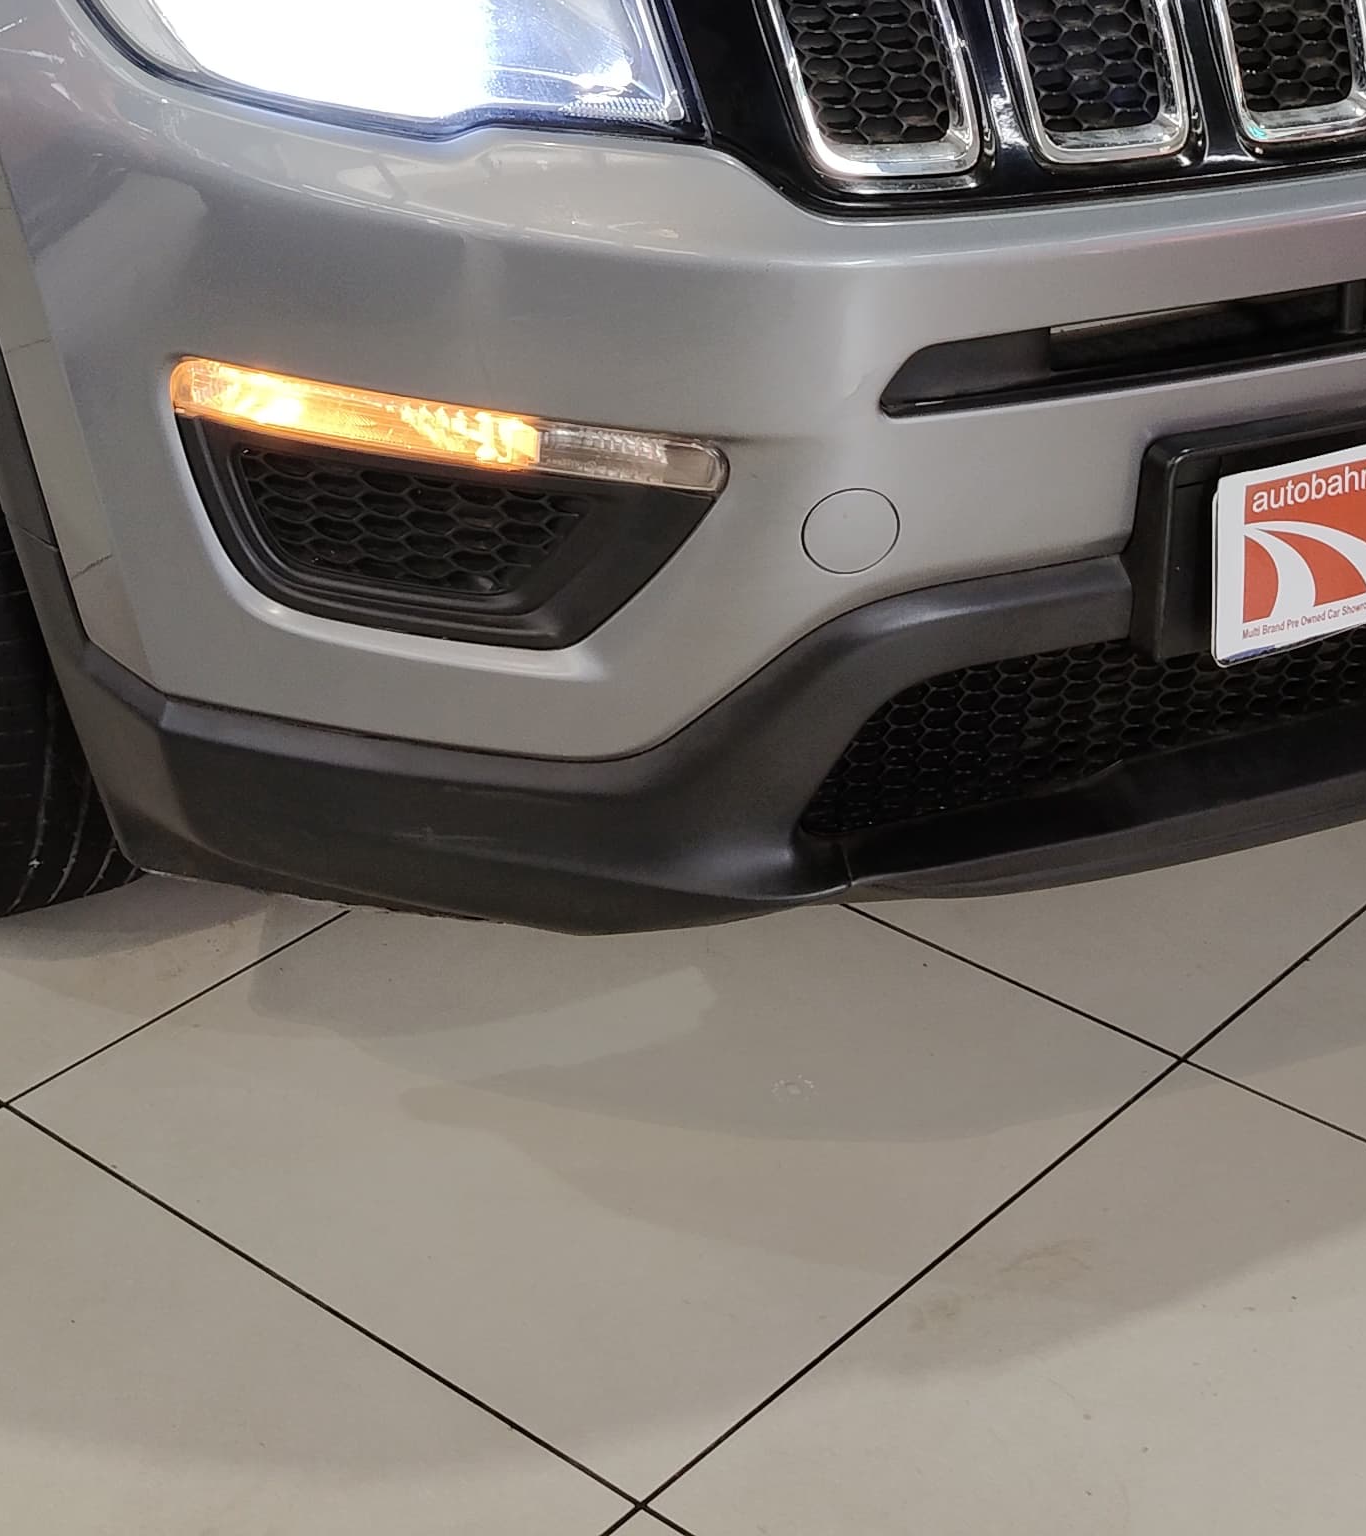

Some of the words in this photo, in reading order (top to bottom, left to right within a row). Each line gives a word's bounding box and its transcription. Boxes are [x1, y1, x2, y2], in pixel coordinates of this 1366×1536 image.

[1242, 624, 1260, 639] Multi
[1262, 622, 1284, 635] Brand
[1287, 618, 1299, 631] Pre
[1300, 610, 1327, 626] Owned
[1327, 608, 1340, 620] Car
